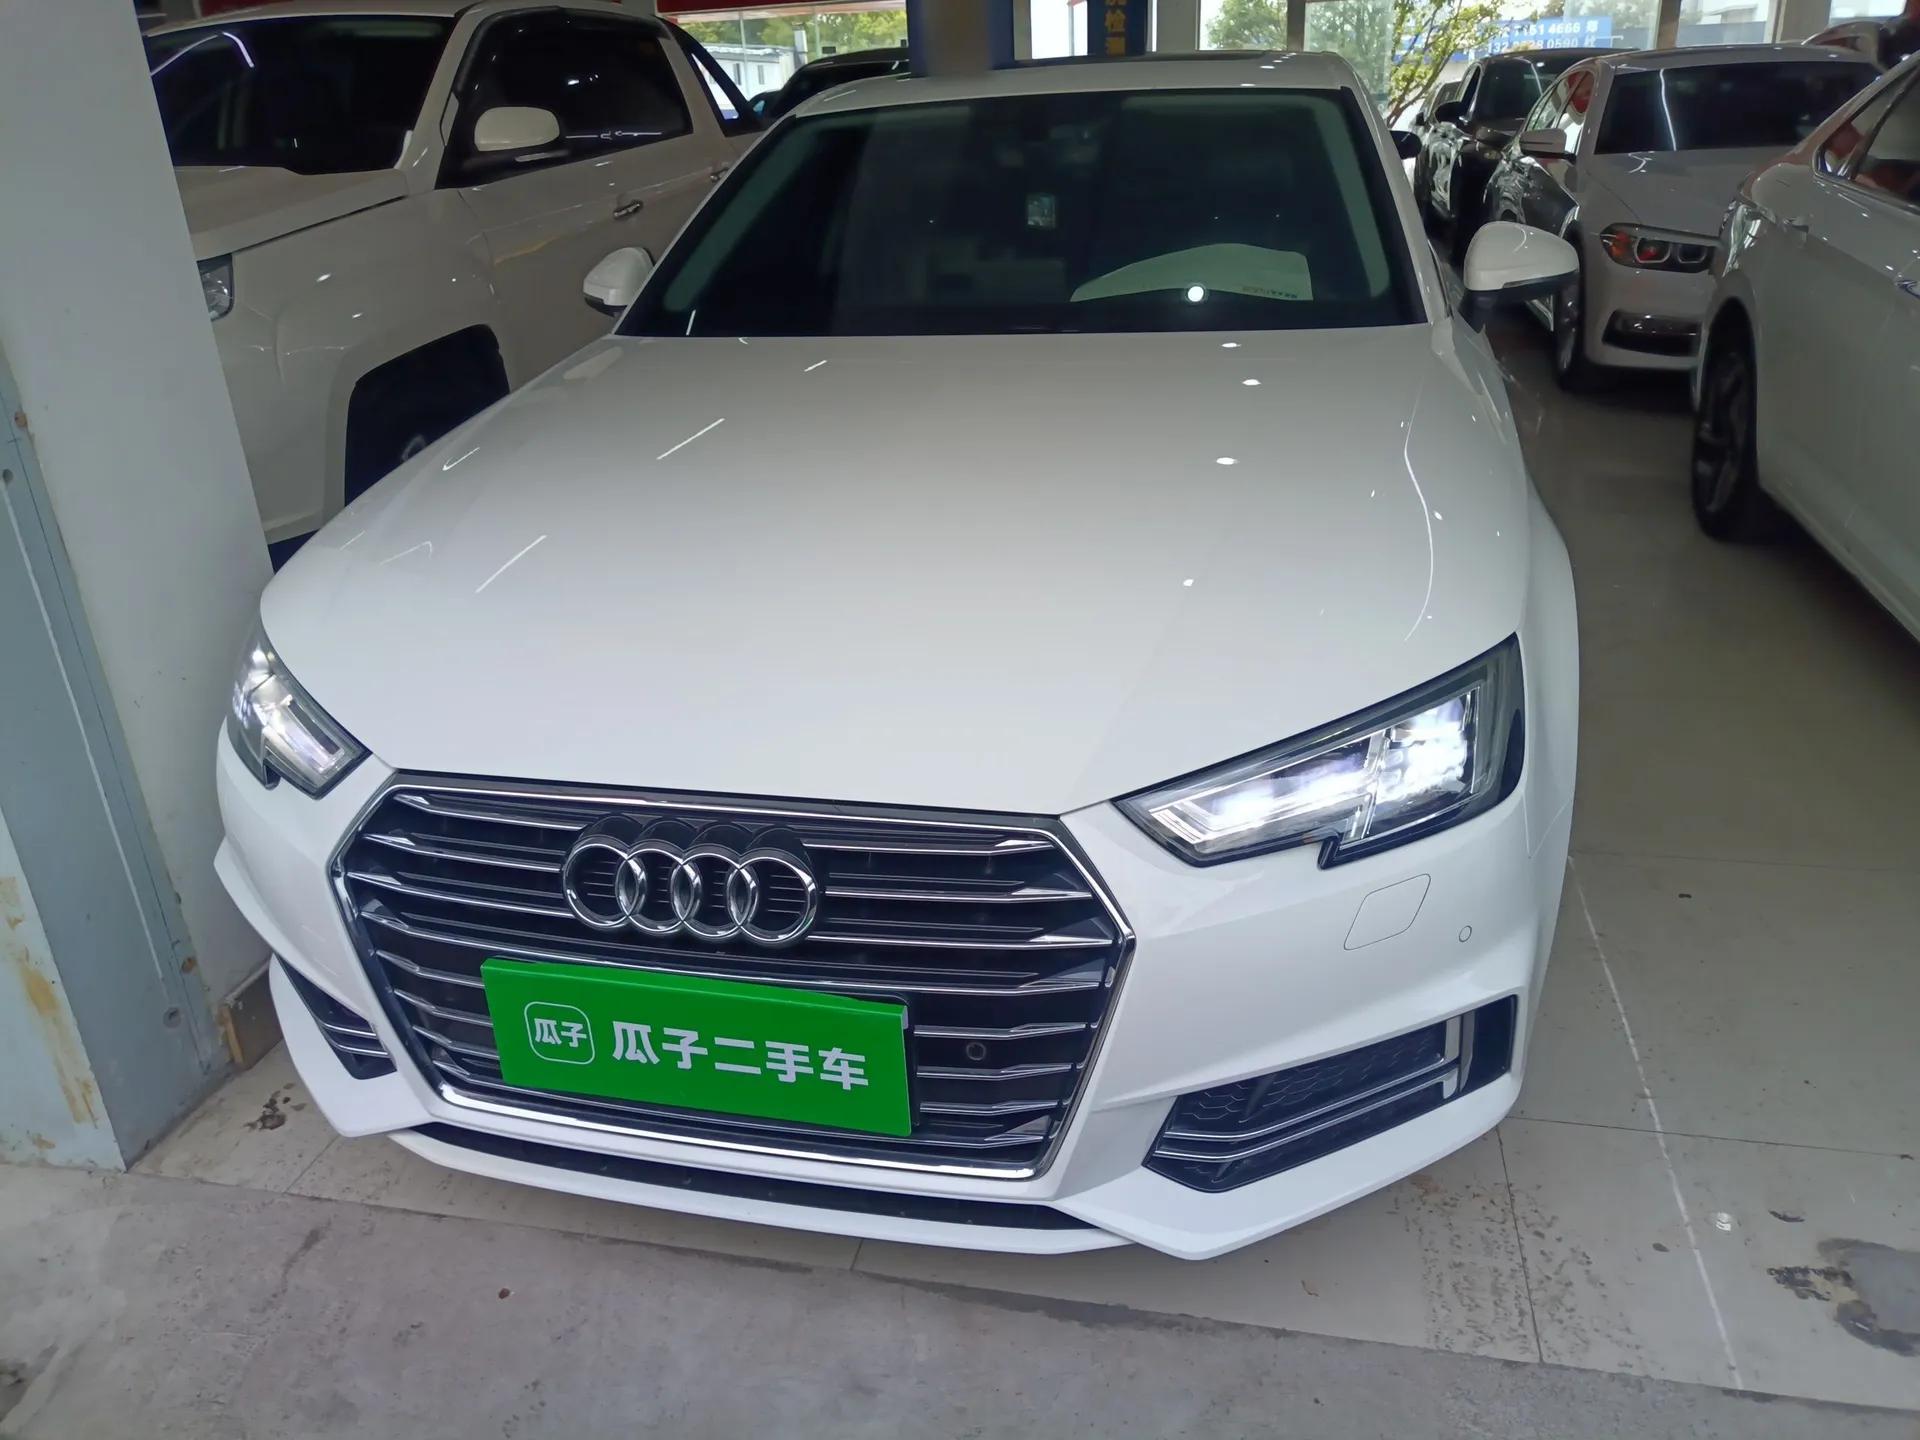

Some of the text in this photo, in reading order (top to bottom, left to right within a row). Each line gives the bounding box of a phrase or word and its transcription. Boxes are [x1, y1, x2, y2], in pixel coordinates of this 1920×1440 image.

[534, 1018, 869, 1090] 瓜子 瓜子二手车
